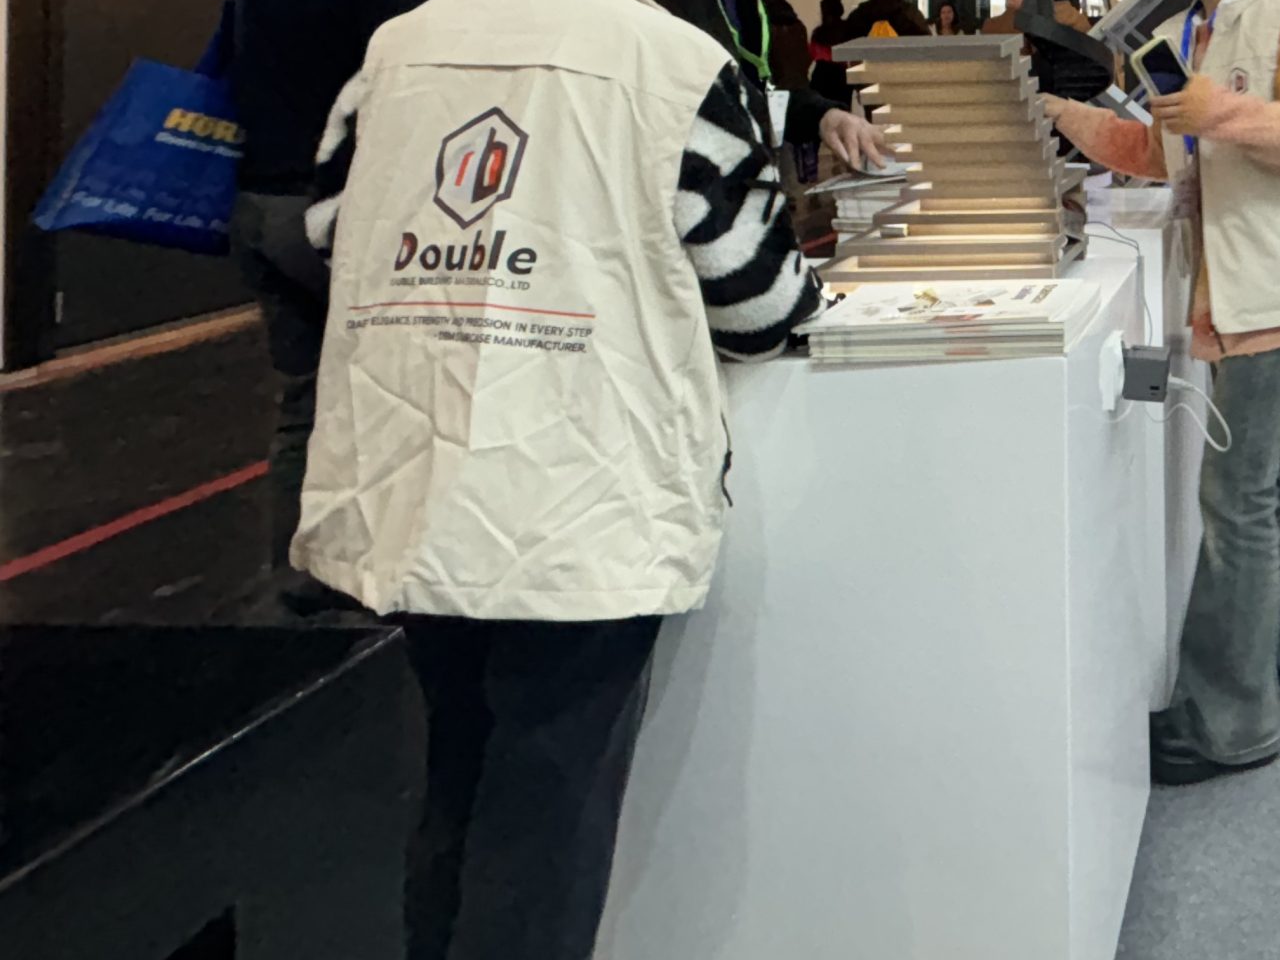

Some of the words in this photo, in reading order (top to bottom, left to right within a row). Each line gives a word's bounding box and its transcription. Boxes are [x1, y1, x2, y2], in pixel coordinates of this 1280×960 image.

[394, 230, 538, 275] Double
[530, 324, 565, 335] EVERY
[566, 327, 593, 338] STEP
